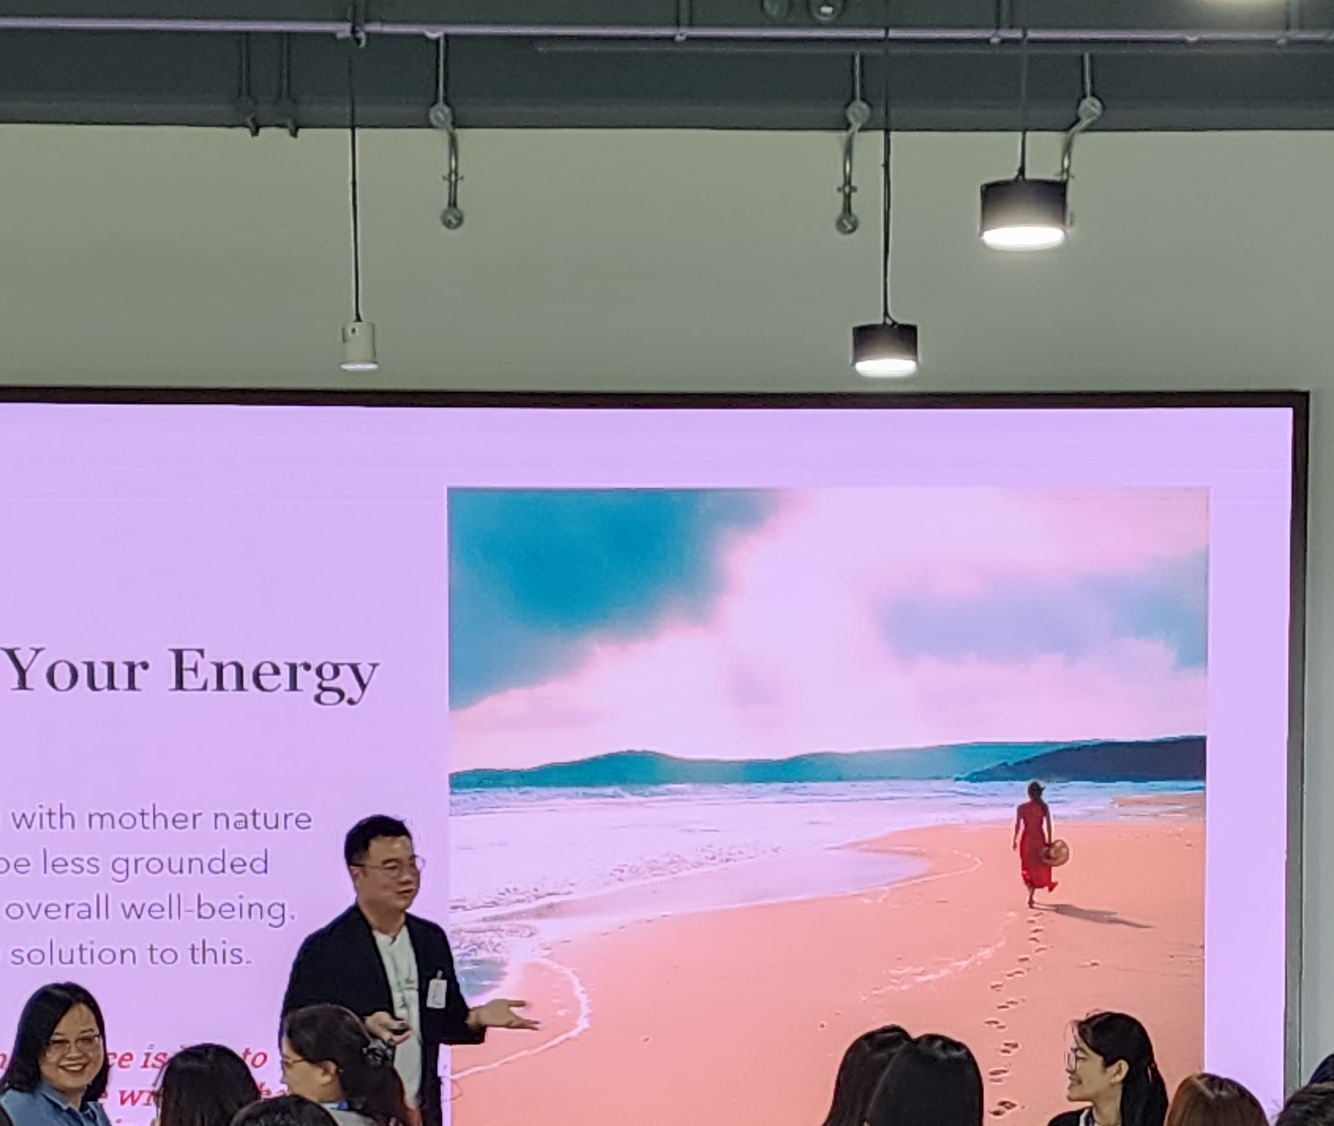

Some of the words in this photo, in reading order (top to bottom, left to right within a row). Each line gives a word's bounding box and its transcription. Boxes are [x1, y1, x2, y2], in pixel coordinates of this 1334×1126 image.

[167, 647, 380, 707] Energy
[10, 802, 76, 831] with
[88, 802, 204, 831] mother
[213, 803, 313, 831] nature
[42, 847, 100, 876] less
[111, 847, 269, 883] grounded
[4, 892, 110, 921] overall
[120, 892, 297, 929] well-being.
[10, 938, 137, 966] solution
[147, 941, 179, 966] to
[188, 938, 252, 966] this.
